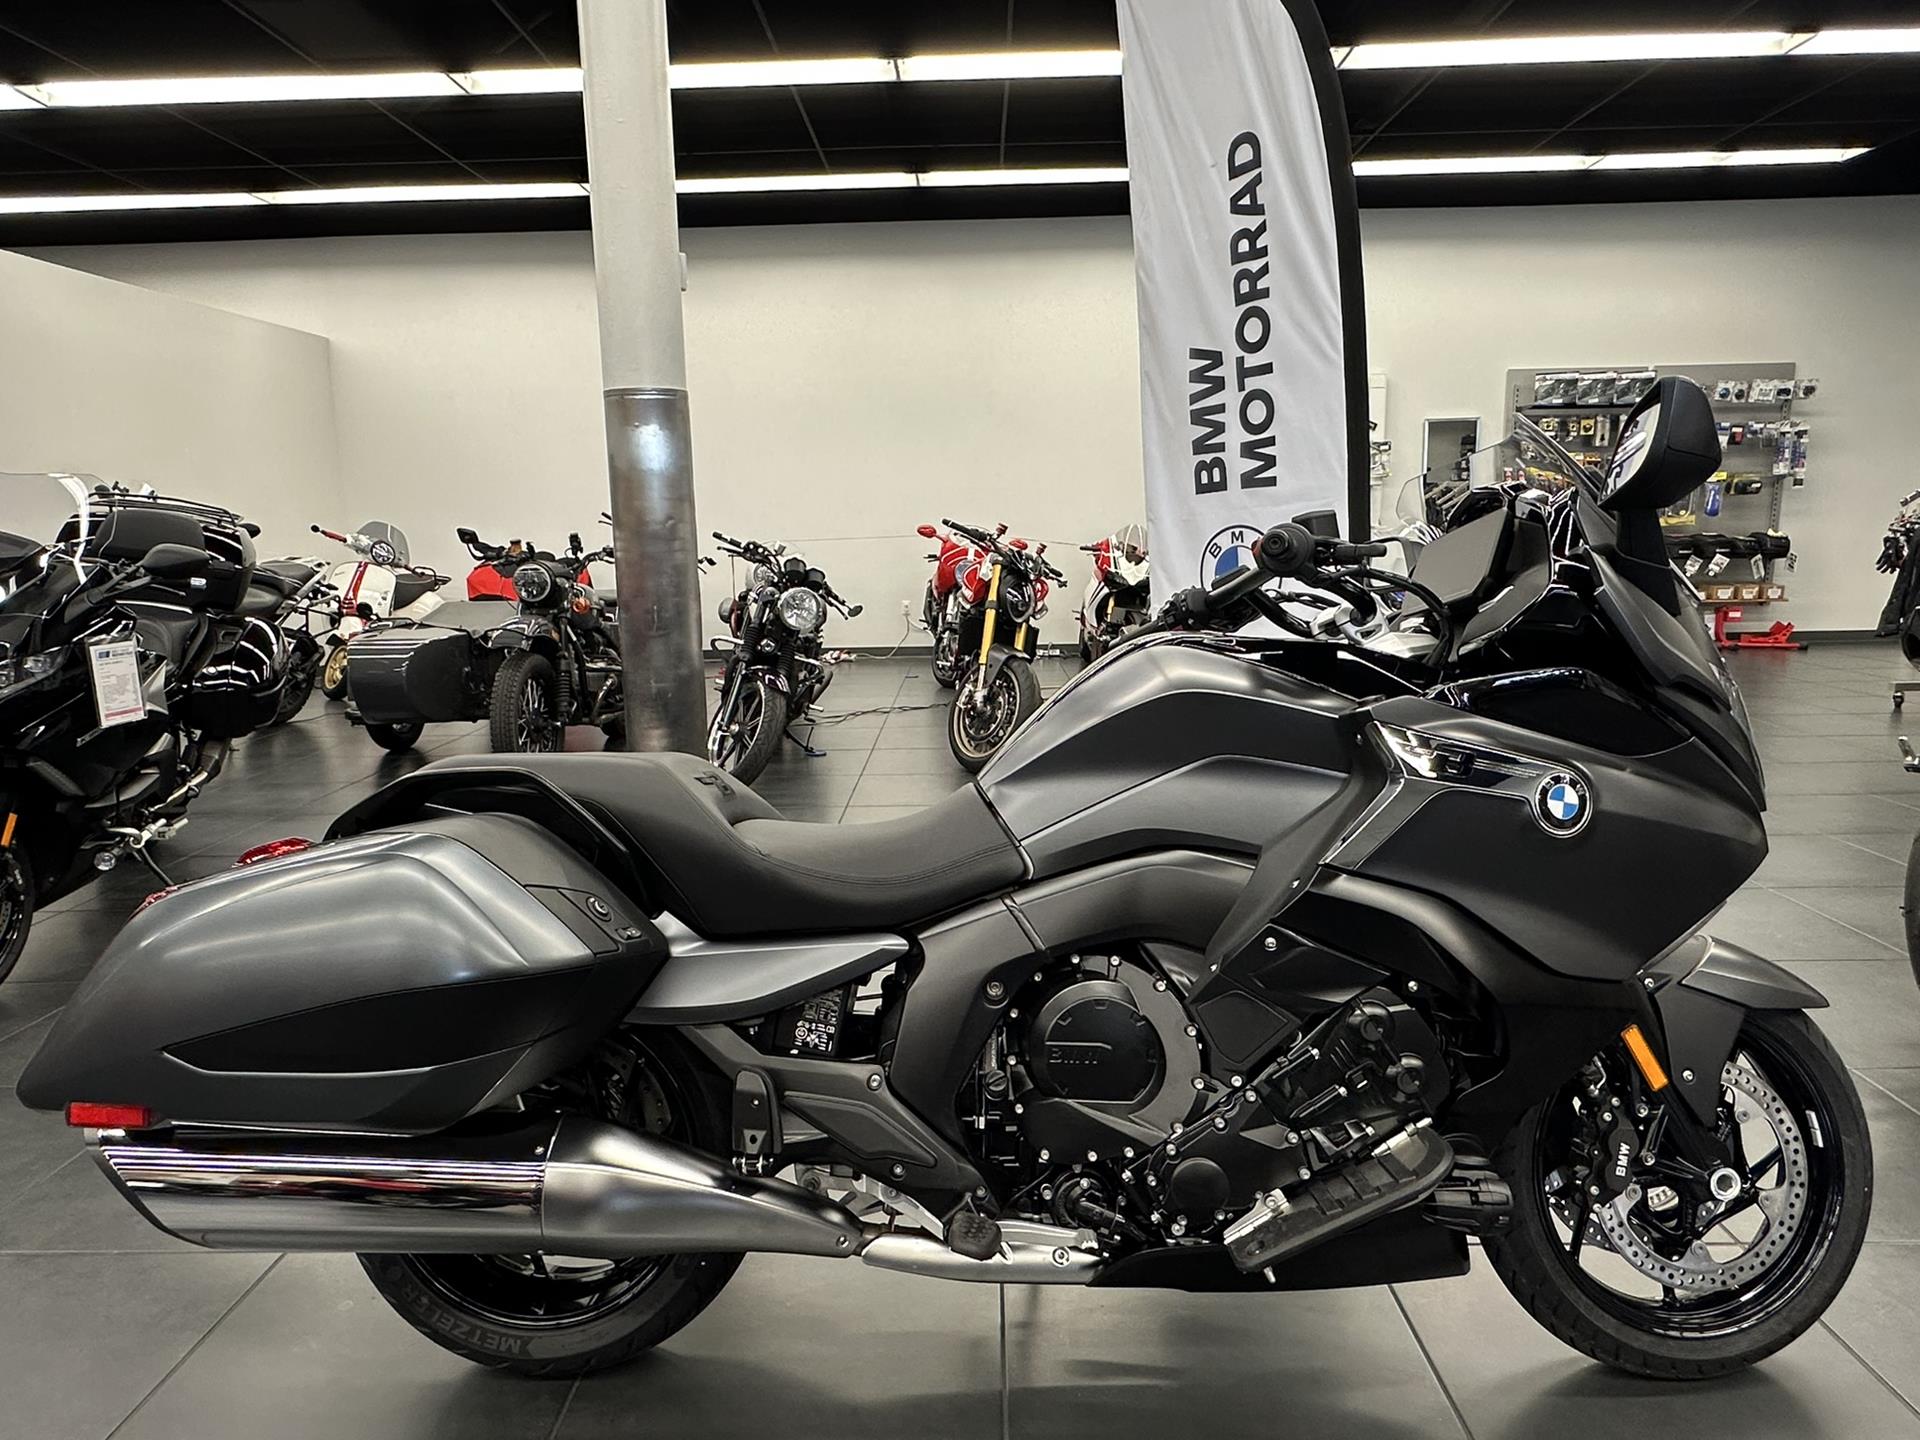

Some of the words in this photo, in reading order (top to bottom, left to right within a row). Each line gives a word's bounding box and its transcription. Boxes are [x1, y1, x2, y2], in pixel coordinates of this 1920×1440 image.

[1227, 131, 1278, 490] MOTORRAD
[1188, 347, 1228, 495] BMW
[1541, 773, 1585, 796] BMW
[1615, 1142, 1631, 1177] BMW
[401, 1282, 522, 1354] METZELER
